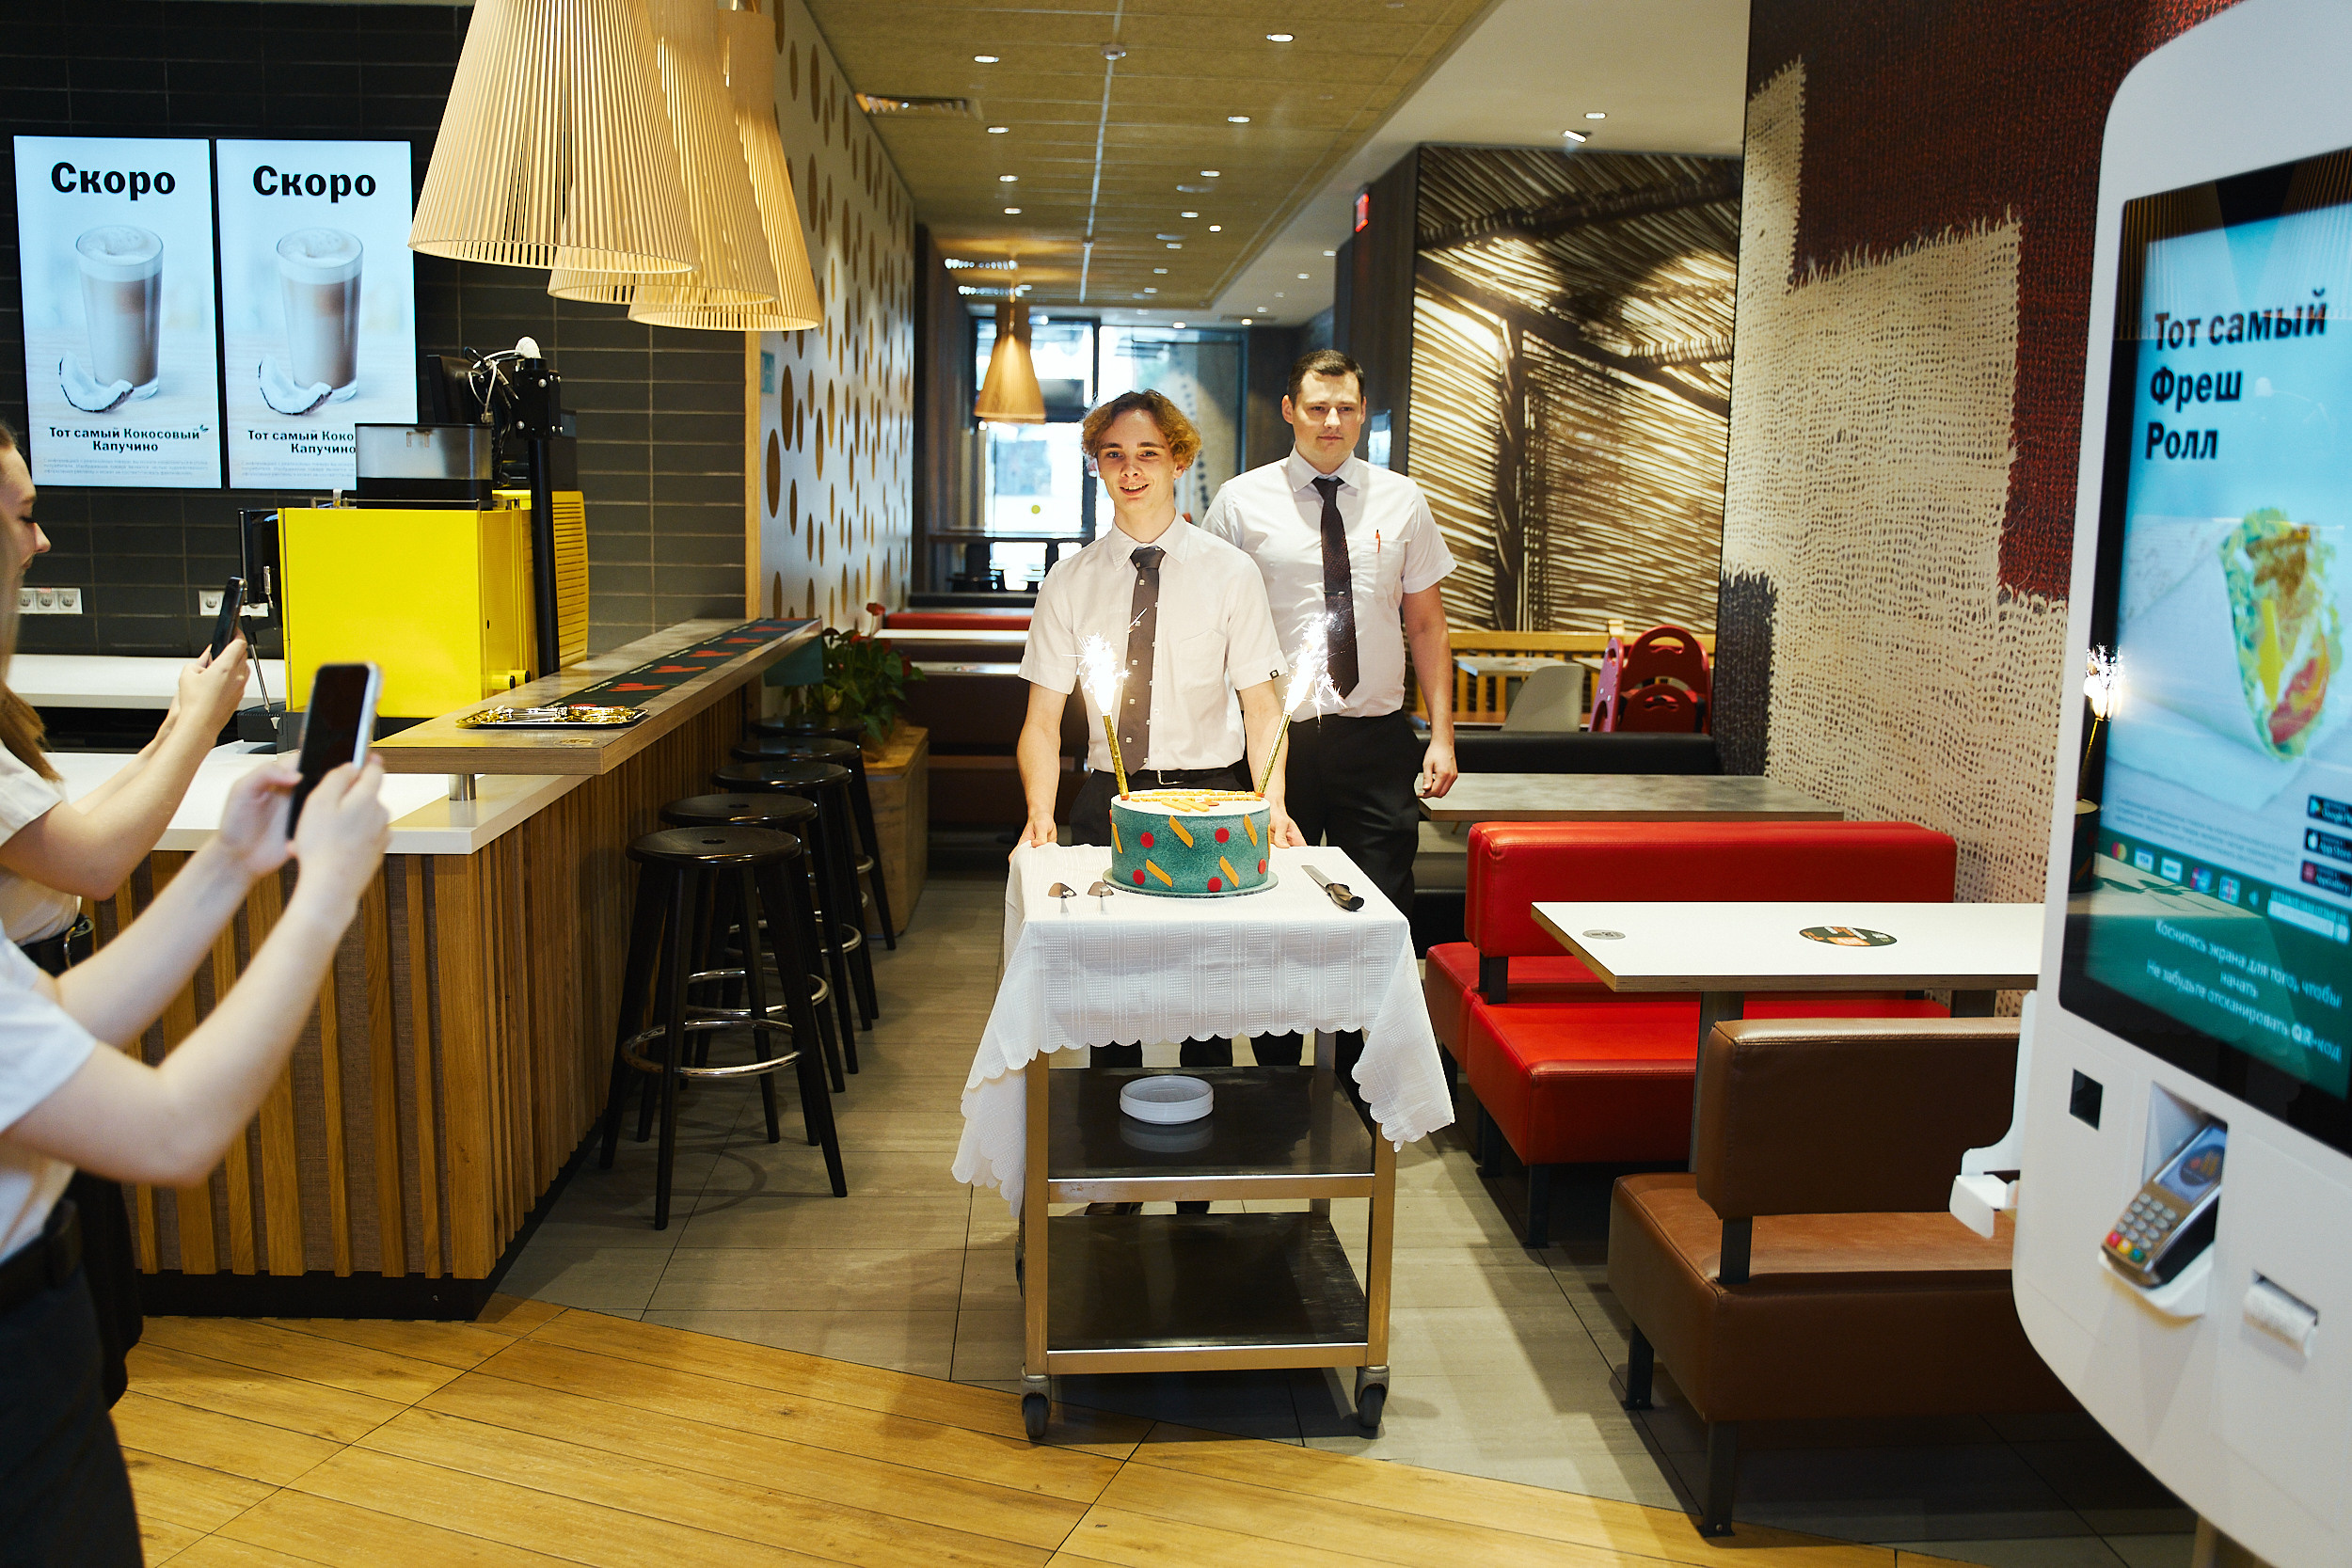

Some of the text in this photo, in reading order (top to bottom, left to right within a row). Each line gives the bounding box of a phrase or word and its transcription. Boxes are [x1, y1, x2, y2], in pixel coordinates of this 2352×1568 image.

[50, 162, 176, 201] Скоро
[252, 165, 376, 203] Скоро
[2154, 288, 2328, 351] Тот самый
[2150, 366, 2242, 412] Фреш
[49, 426, 200, 440] Тот самый Кокосовый
[92, 440, 159, 453] Капучино
[247, 430, 269, 441] Тот
[272, 429, 318, 442] самый
[290, 442, 356, 455] Капучино
[2145, 421, 2218, 459] Ролл
[2155, 919, 2343, 1008] Коснитесь экрана для того, чтобы
[2219, 971, 2259, 999] начать
[2147, 958, 2343, 1063] Не забудьте отсканировать QR-код
